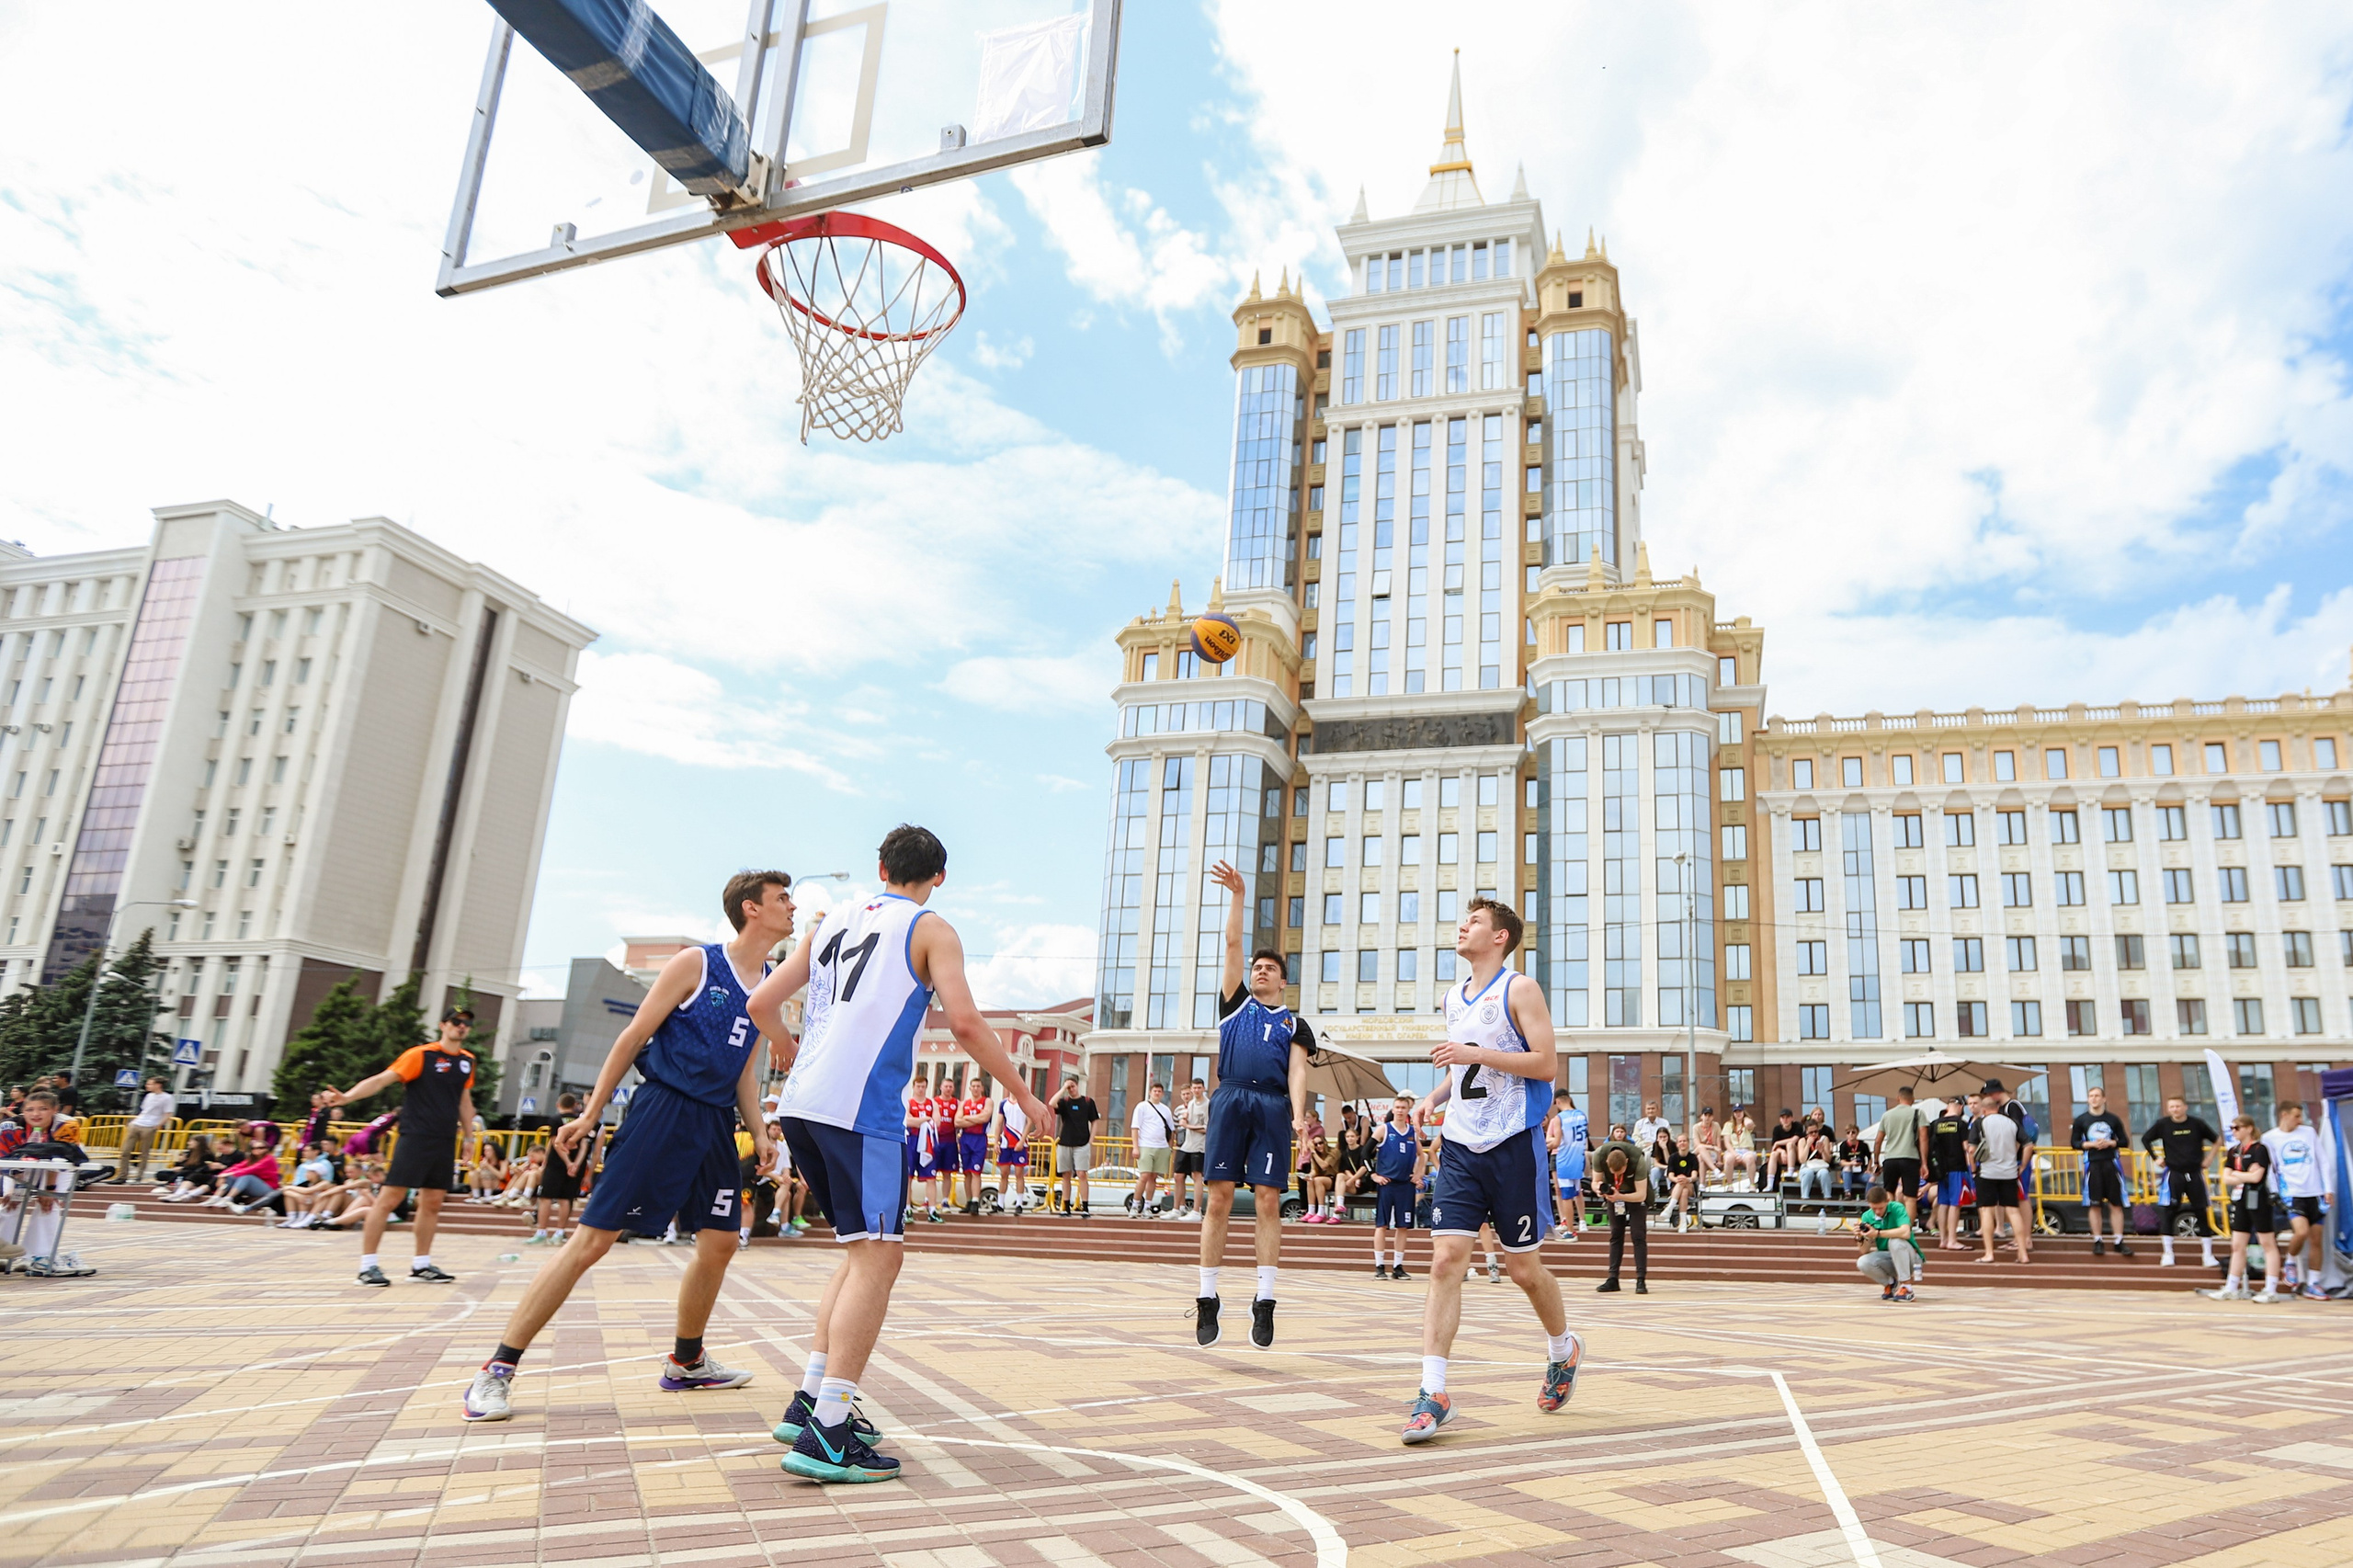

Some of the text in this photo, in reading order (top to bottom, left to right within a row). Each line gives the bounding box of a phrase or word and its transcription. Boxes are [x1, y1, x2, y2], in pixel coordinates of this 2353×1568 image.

[817, 927, 881, 1006] 11
[1324, 1024, 1448, 1032] ГОСУДАРСТВЕННЫЙ УНИВЕРСИТЕ
[1361, 1016, 1414, 1024] МОРДОВСКИЙ
[727, 1016, 750, 1048] 5
[1263, 1022, 1272, 1042] 1
[1461, 1041, 1487, 1100] 2
[1399, 1142, 1406, 1153] 9
[1265, 1153, 1273, 1175] 1
[710, 1188, 734, 1217] 5
[1404, 1211, 1411, 1222] 9
[1518, 1214, 1532, 1243] 2
